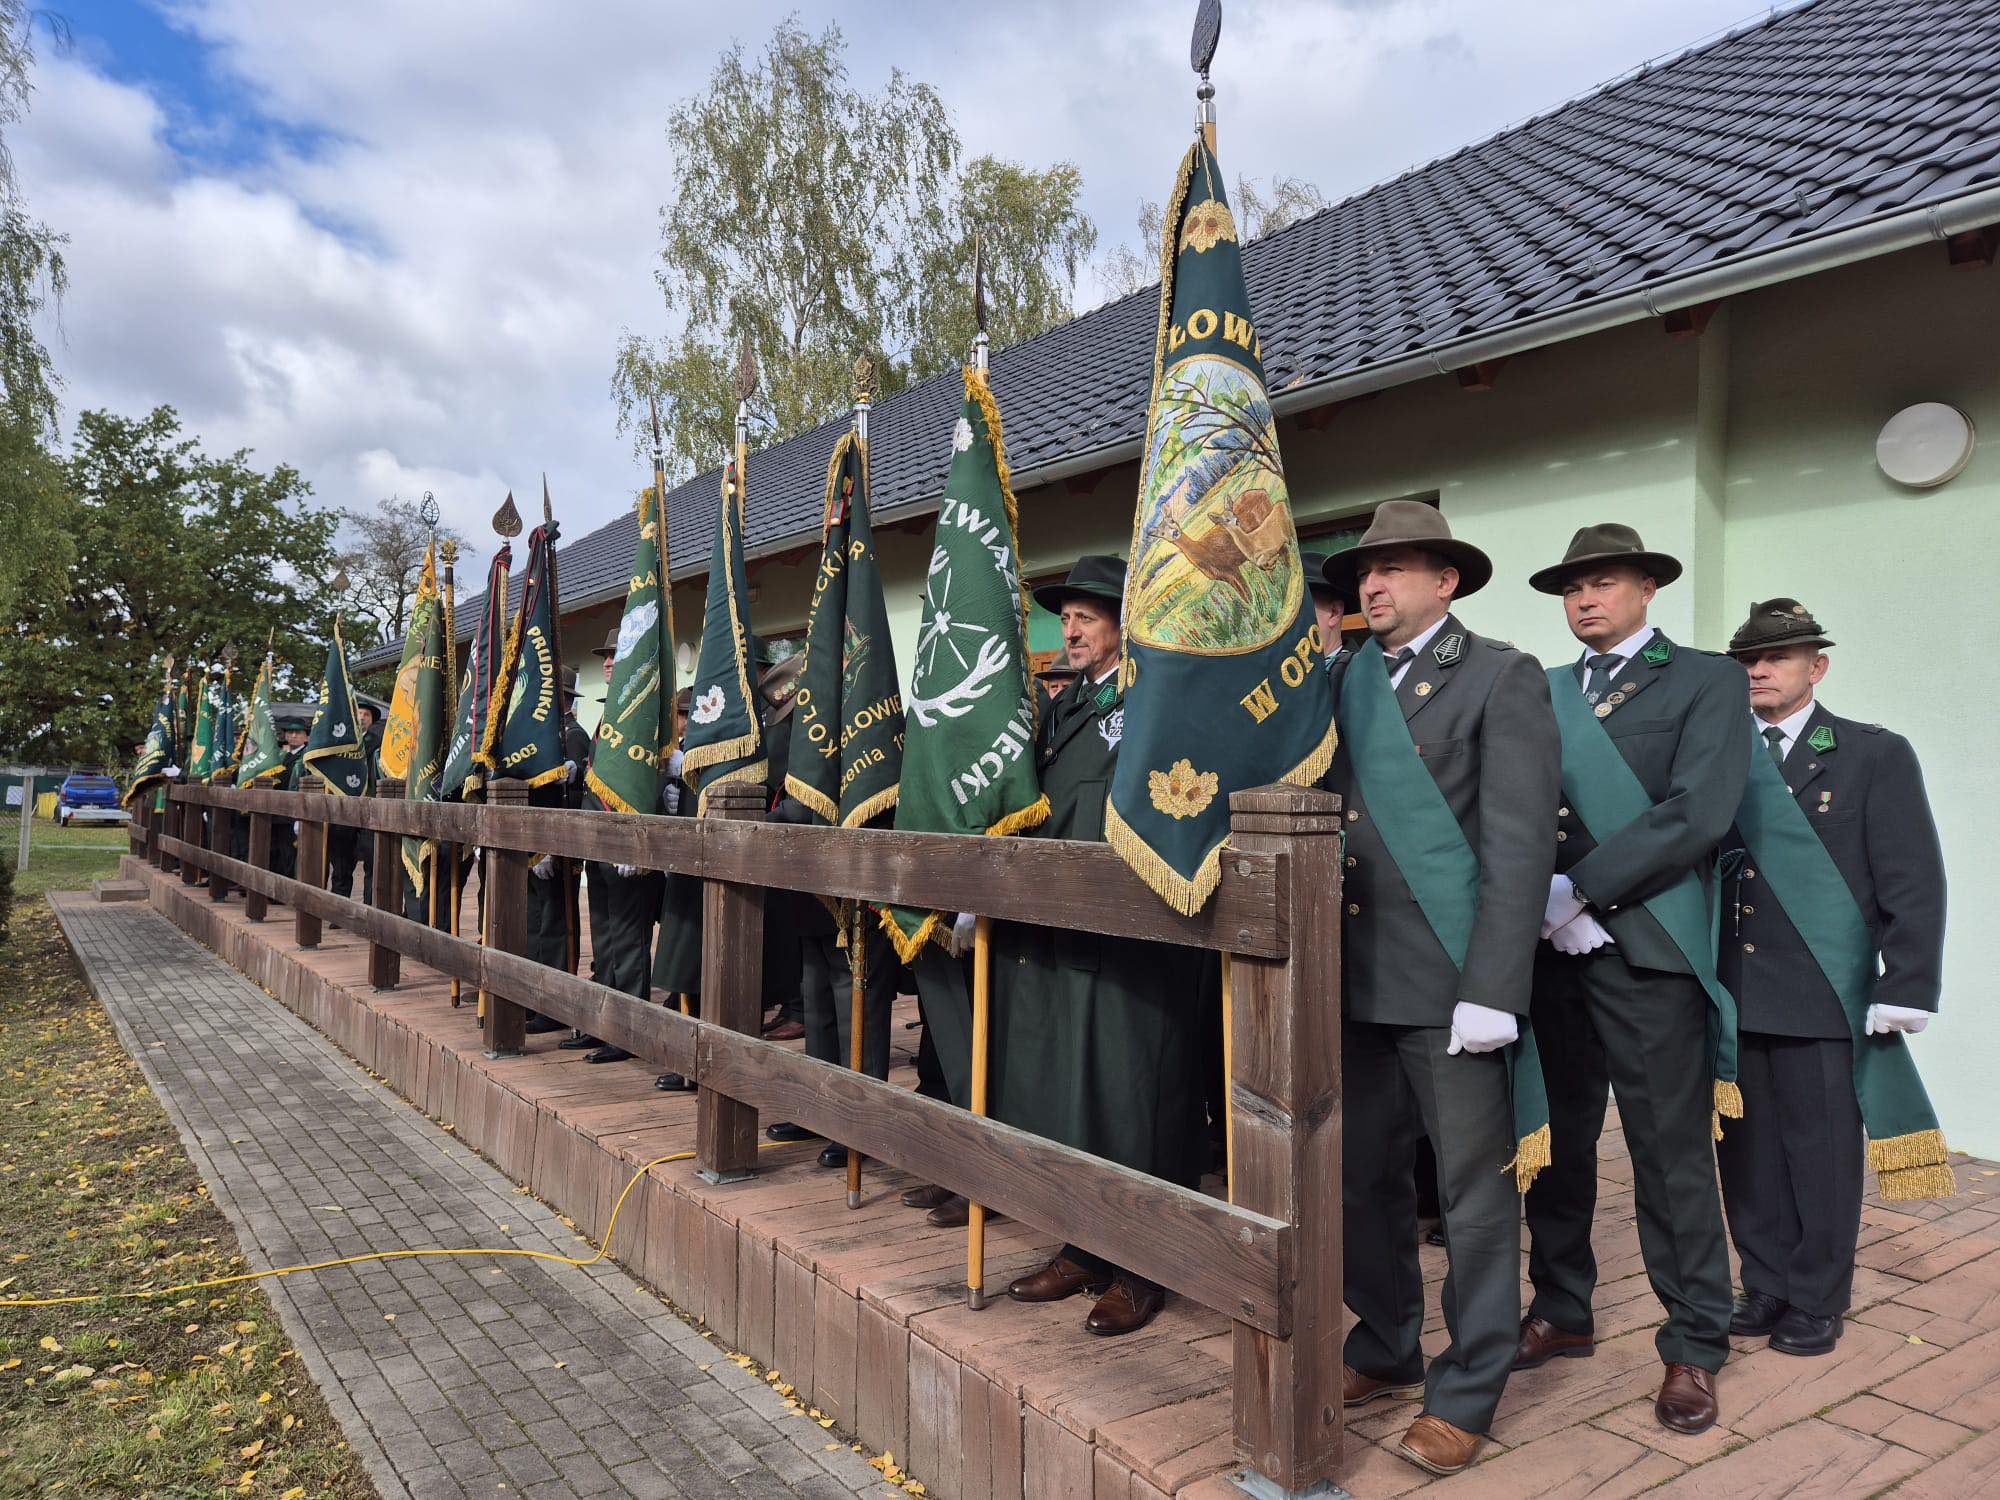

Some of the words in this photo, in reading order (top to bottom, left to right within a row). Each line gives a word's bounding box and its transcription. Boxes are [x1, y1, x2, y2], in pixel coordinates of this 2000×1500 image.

[527, 625, 554, 722] PRUDNIKU
[1239, 678, 1280, 724] W
[796, 687, 838, 759] KOŁO
[502, 743, 538, 769] 2003
